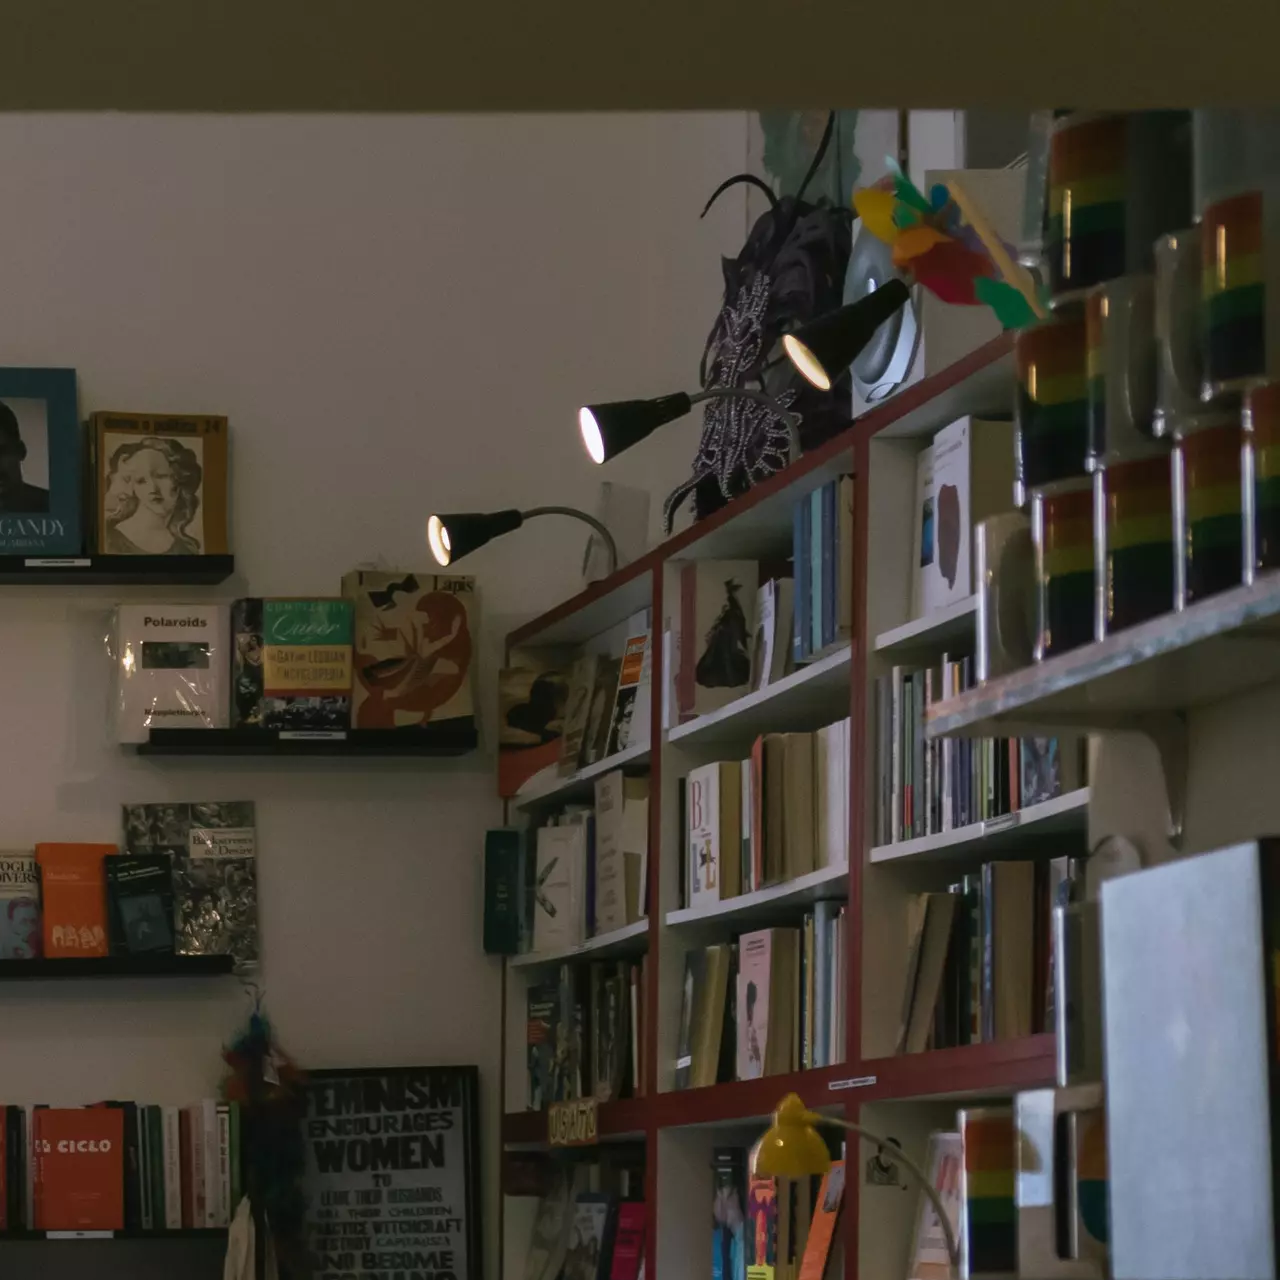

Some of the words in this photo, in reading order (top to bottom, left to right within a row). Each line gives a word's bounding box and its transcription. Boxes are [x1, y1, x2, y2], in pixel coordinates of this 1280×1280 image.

[144, 616, 207, 628] Polaroids
[272, 614, 340, 642] Queer
[308, 1112, 454, 1138] ENCOURAGES
[57, 1139, 112, 1153] CICLO
[314, 1134, 445, 1173] WOMEN
[371, 1174, 392, 1187] TO
[373, 1219, 462, 1235] WITCHCRAFT
[362, 1250, 454, 1270] BECOME
